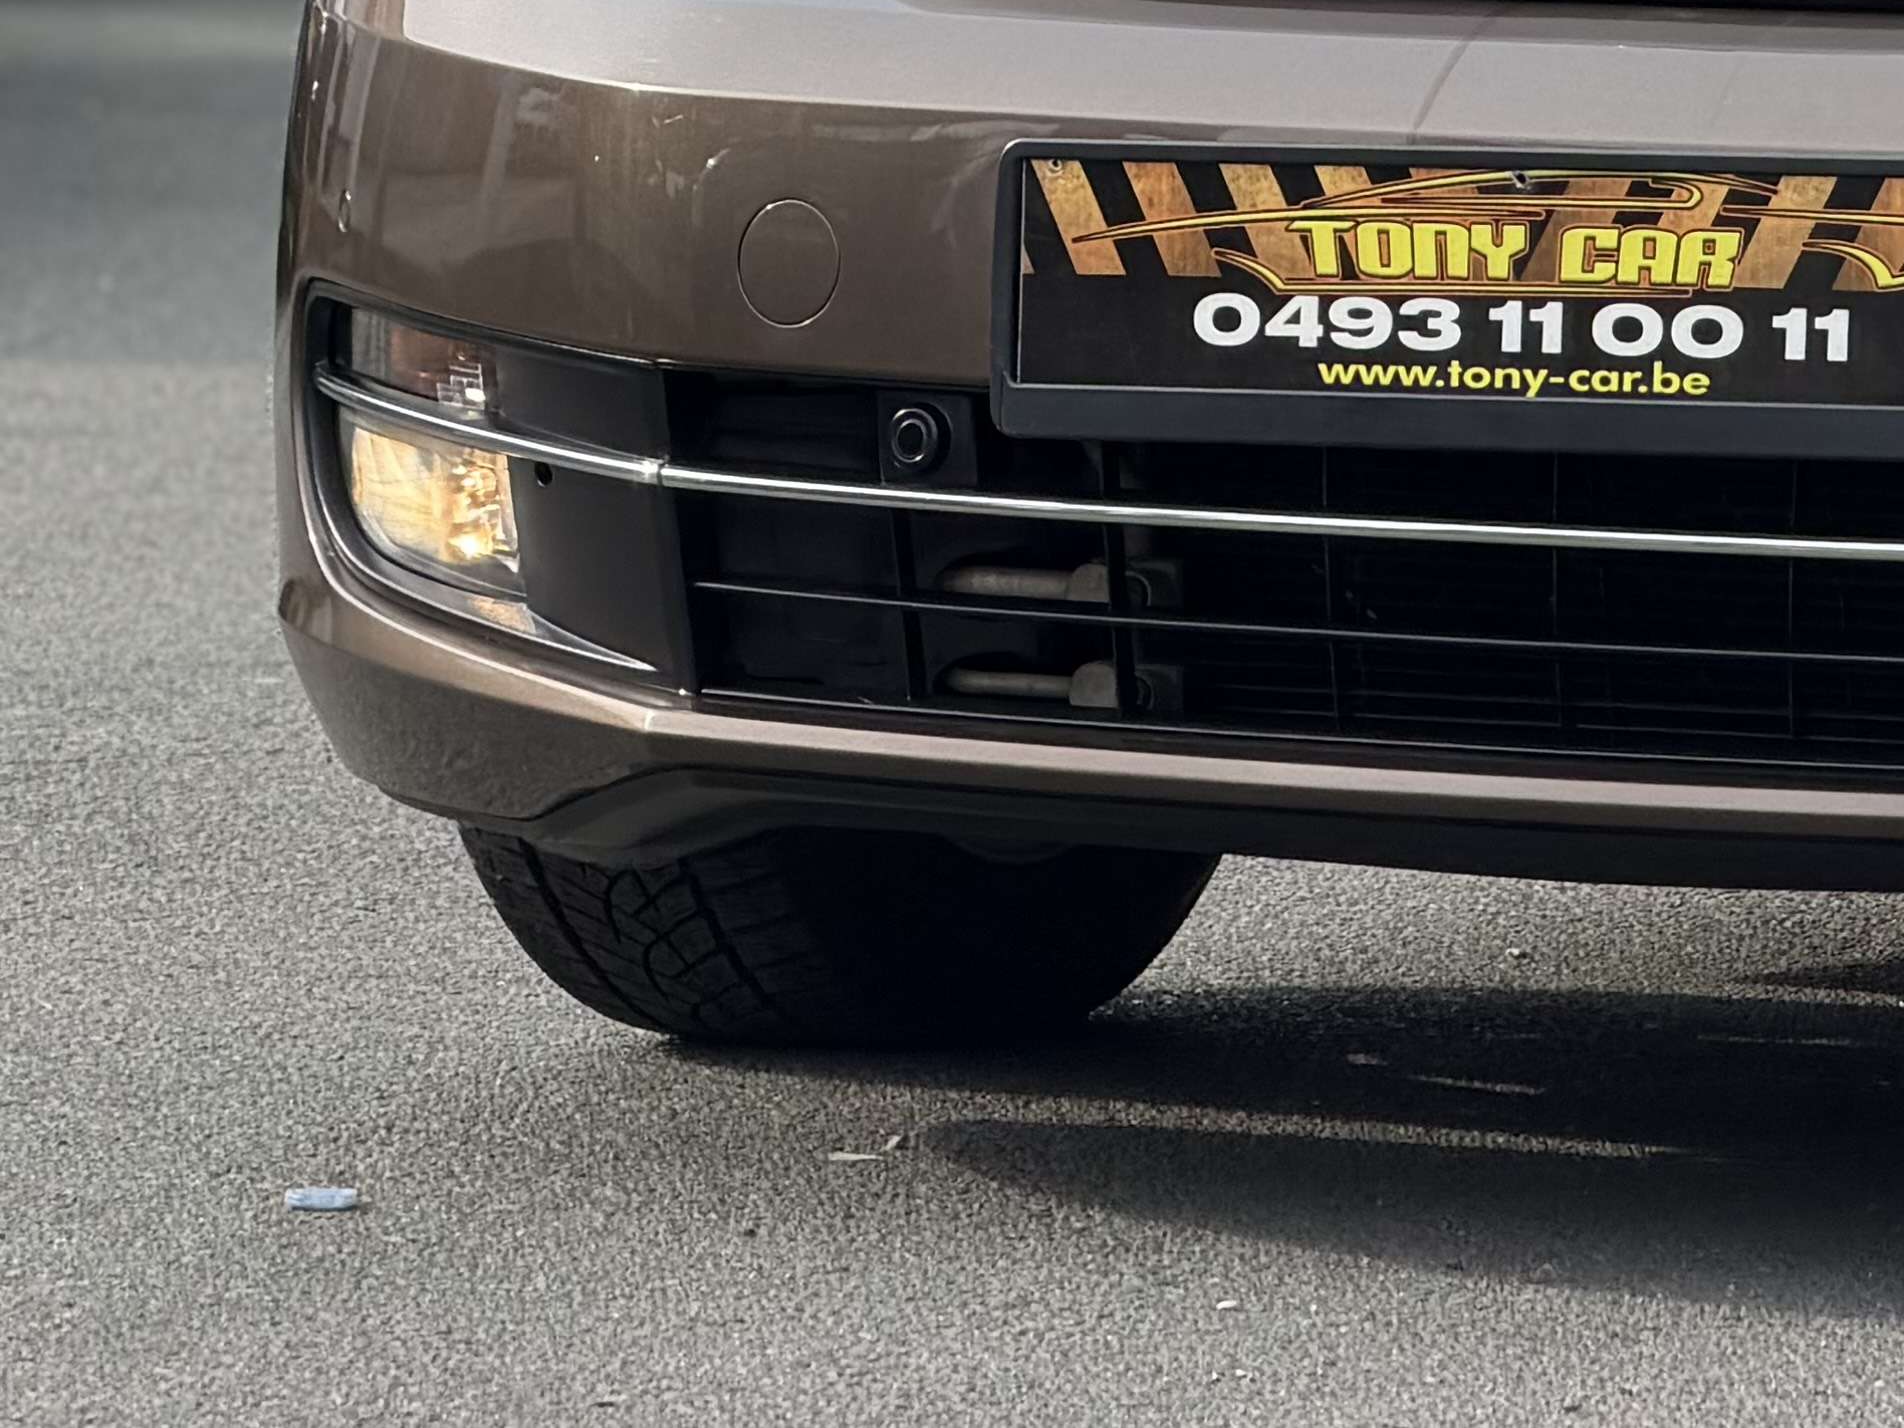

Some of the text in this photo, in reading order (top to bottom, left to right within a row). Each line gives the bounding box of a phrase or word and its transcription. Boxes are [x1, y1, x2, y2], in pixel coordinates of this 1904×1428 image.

[1287, 220, 1742, 287] TONY CAR
[1193, 292, 1850, 362] 0493 11 00 11
[1317, 360, 1711, 398] www.tony-car.be
